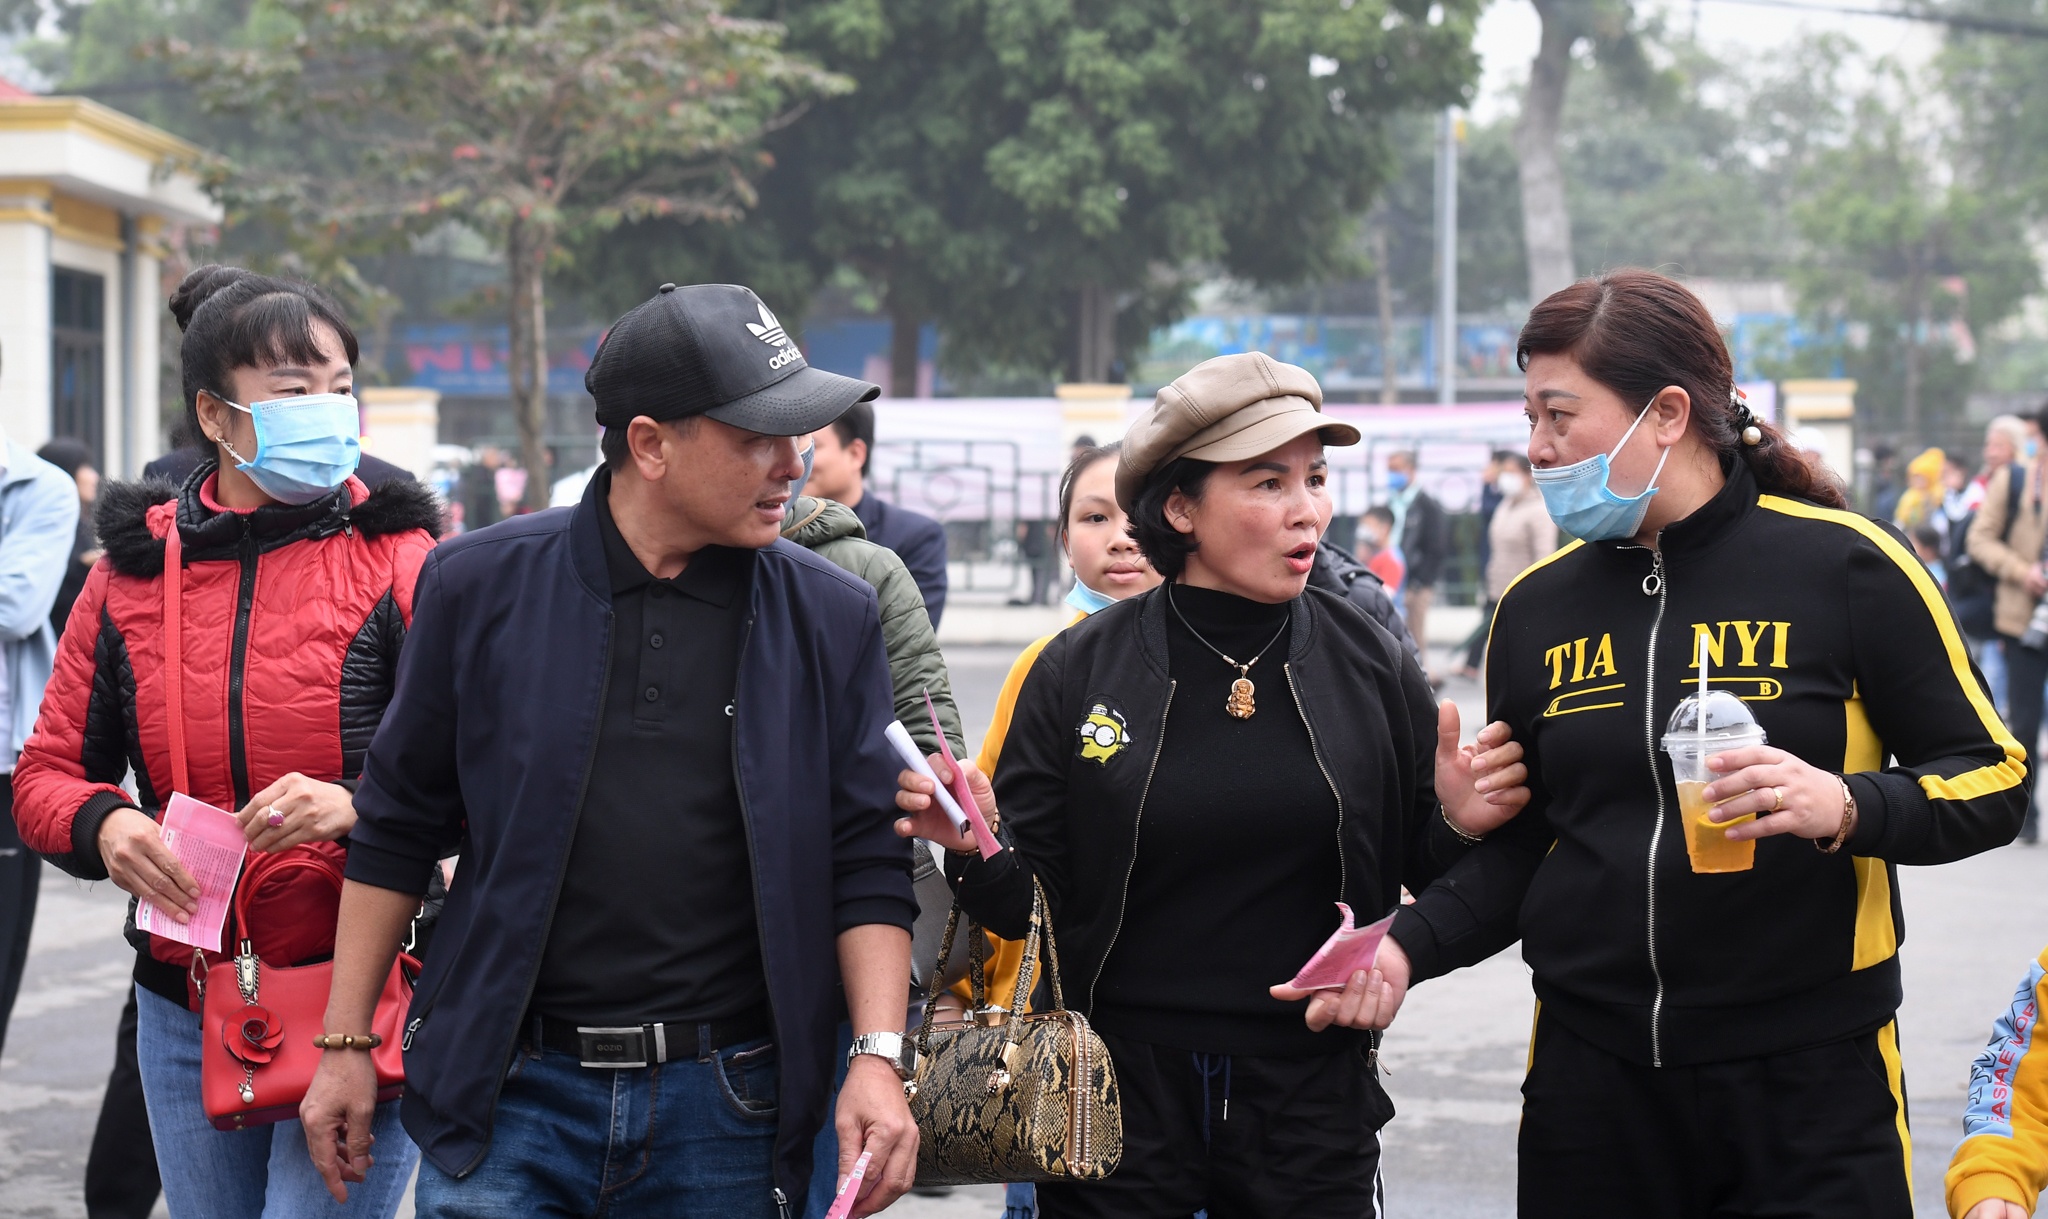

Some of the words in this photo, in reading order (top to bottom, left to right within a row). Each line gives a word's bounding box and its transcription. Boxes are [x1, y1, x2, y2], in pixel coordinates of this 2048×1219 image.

[1545, 633, 1617, 690] TIA
[1688, 620, 1791, 669] NYI
[1759, 682, 1772, 695] B
